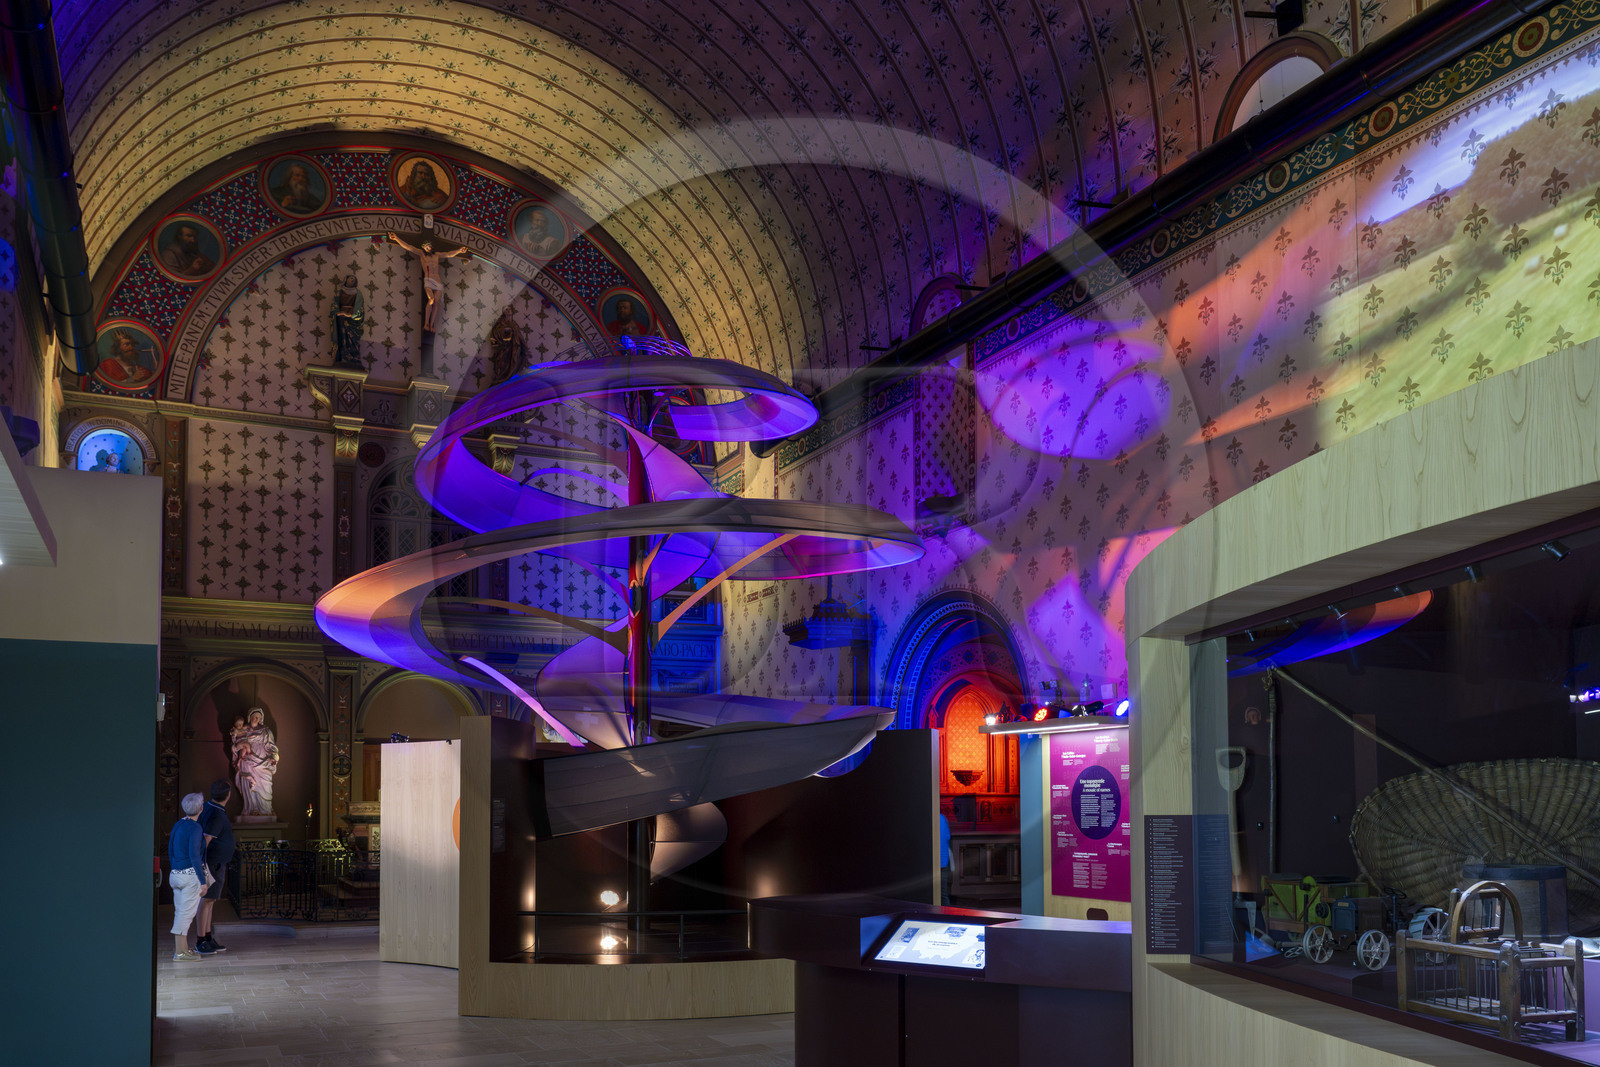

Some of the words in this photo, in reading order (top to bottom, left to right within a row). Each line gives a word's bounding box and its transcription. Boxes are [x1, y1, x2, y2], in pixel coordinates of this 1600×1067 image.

[170, 355, 190, 395] MITTE
[180, 309, 211, 354] PANEM
[203, 277, 236, 309] TVVM
[233, 247, 272, 280] SVPER
[270, 216, 372, 252] TRANSEVNTES
[377, 216, 421, 232] AQVAS
[433, 223, 462, 243] QVIA
[466, 234, 502, 257] POST
[510, 253, 565, 302] TEMPORA
[564, 300, 598, 341] MULTA
[161, 618, 208, 636] OMVM
[215, 620, 262, 638] ISTAM
[653, 642, 679, 656] ABO
[681, 643, 714, 658] PACEM
